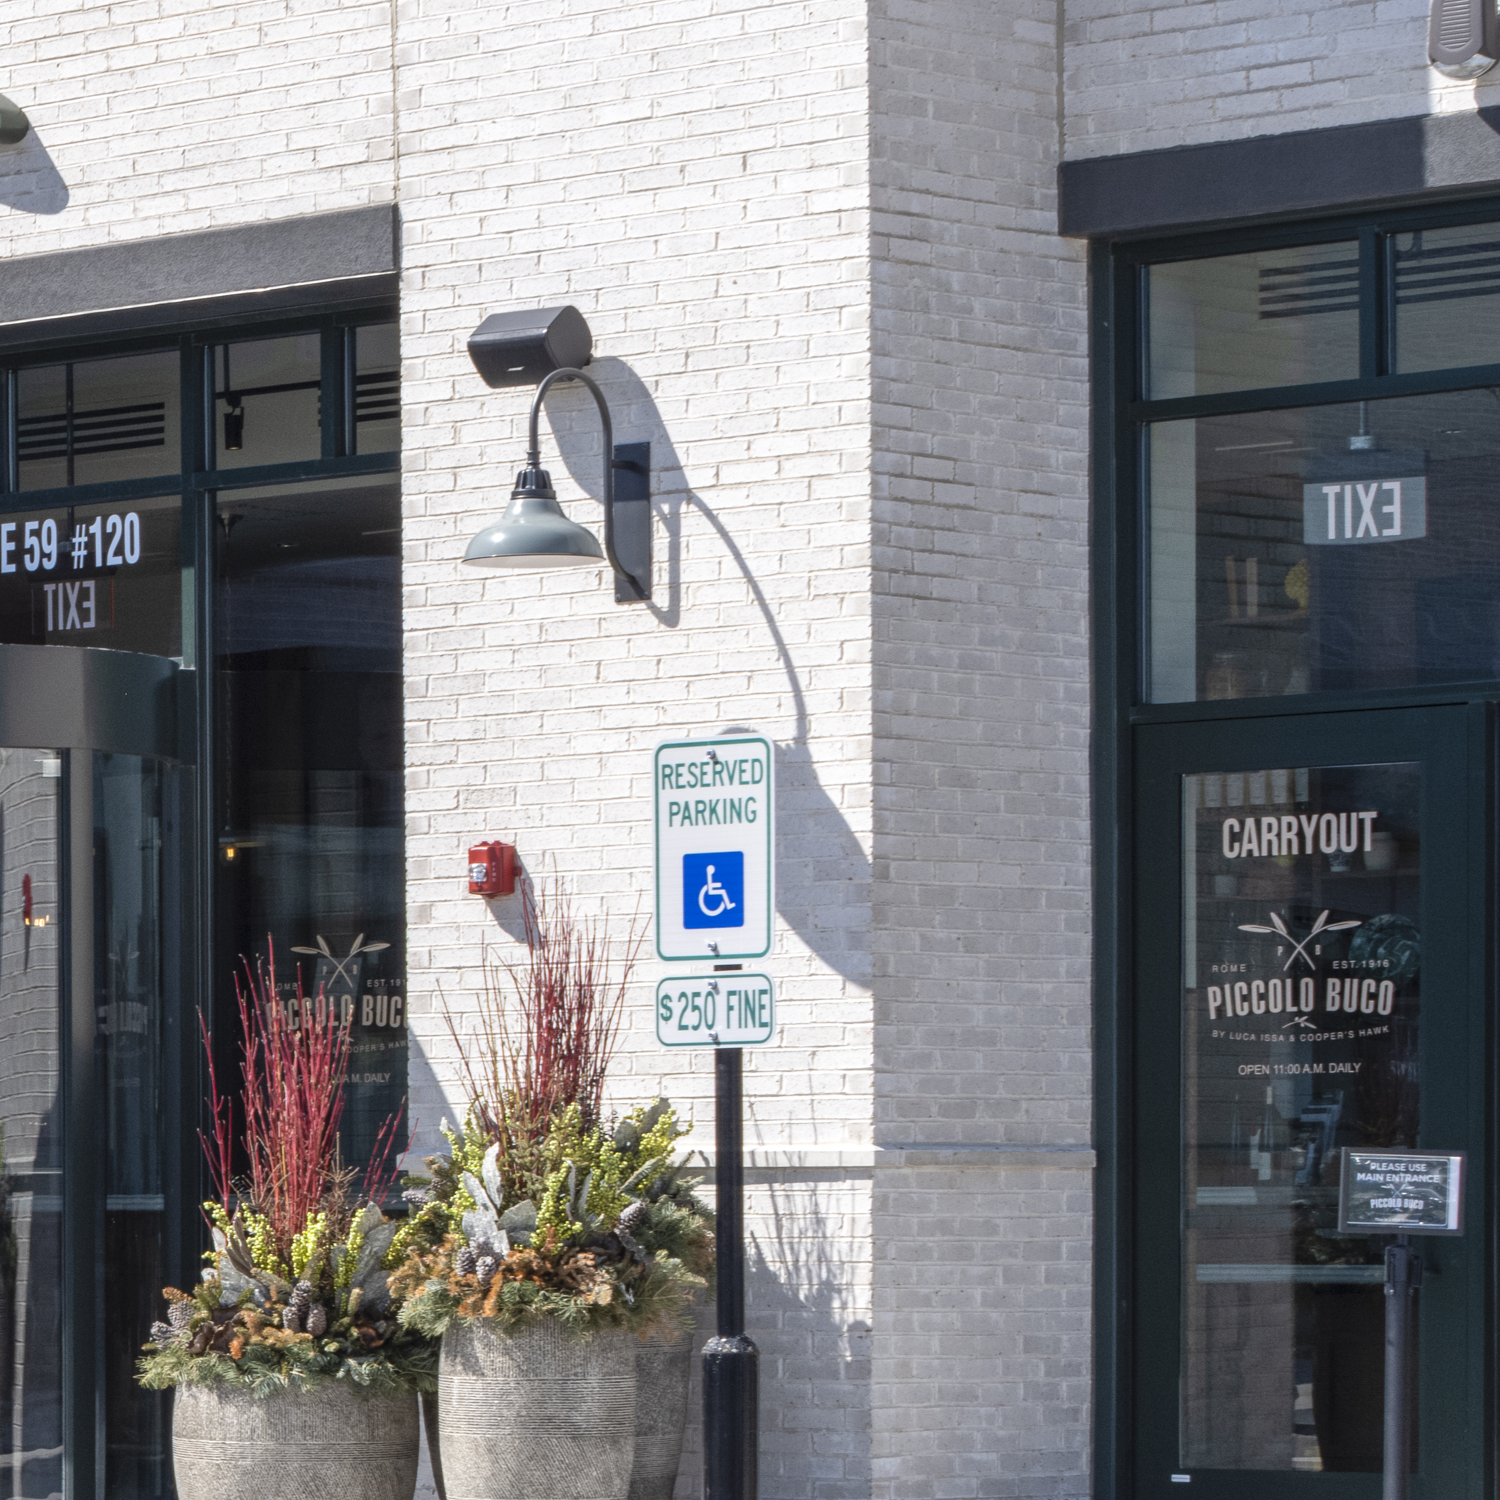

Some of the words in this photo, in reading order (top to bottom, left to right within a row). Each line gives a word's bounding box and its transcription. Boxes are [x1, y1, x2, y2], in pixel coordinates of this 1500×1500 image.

[24, 518, 58, 572] 59
[71, 512, 141, 570] #120
[661, 758, 764, 790] RESERVED
[668, 796, 757, 827] PARKING
[1222, 811, 1378, 858] CARRYOUT
[1212, 964, 1247, 973] ROME
[1333, 960, 1358, 969] EST.
[1361, 959, 1390, 968] 1916
[1207, 977, 1314, 1019] PICCOLO
[1326, 977, 1395, 1016] BUCO
[726, 989, 769, 1030] FINE
[1212, 1030, 1226, 1038] BY
[1229, 1031, 1256, 1041] LUCA
[1260, 1033, 1285, 1042] ISSA
[1289, 1034, 1295, 1042] &
[1300, 1030, 1354, 1042] COOPER'S
[1359, 1025, 1390, 1037] HAWK
[364, 1072, 391, 1083] DAILY
[1238, 1064, 1270, 1076] OPEN
[1273, 1063, 1300, 1075] 11:00
[1302, 1063, 1327, 1074] A.M.
[1329, 1062, 1362, 1074] DAILY
[1370, 1162, 1406, 1171] PLEASE
[1408, 1163, 1427, 1172] USE
[1357, 1172, 1384, 1182] MAIN
[1386, 1173, 1440, 1183] ENTRANCE
[1370, 1199, 1402, 1209] PICCOLO
[1404, 1199, 1424, 1210] BUCO
